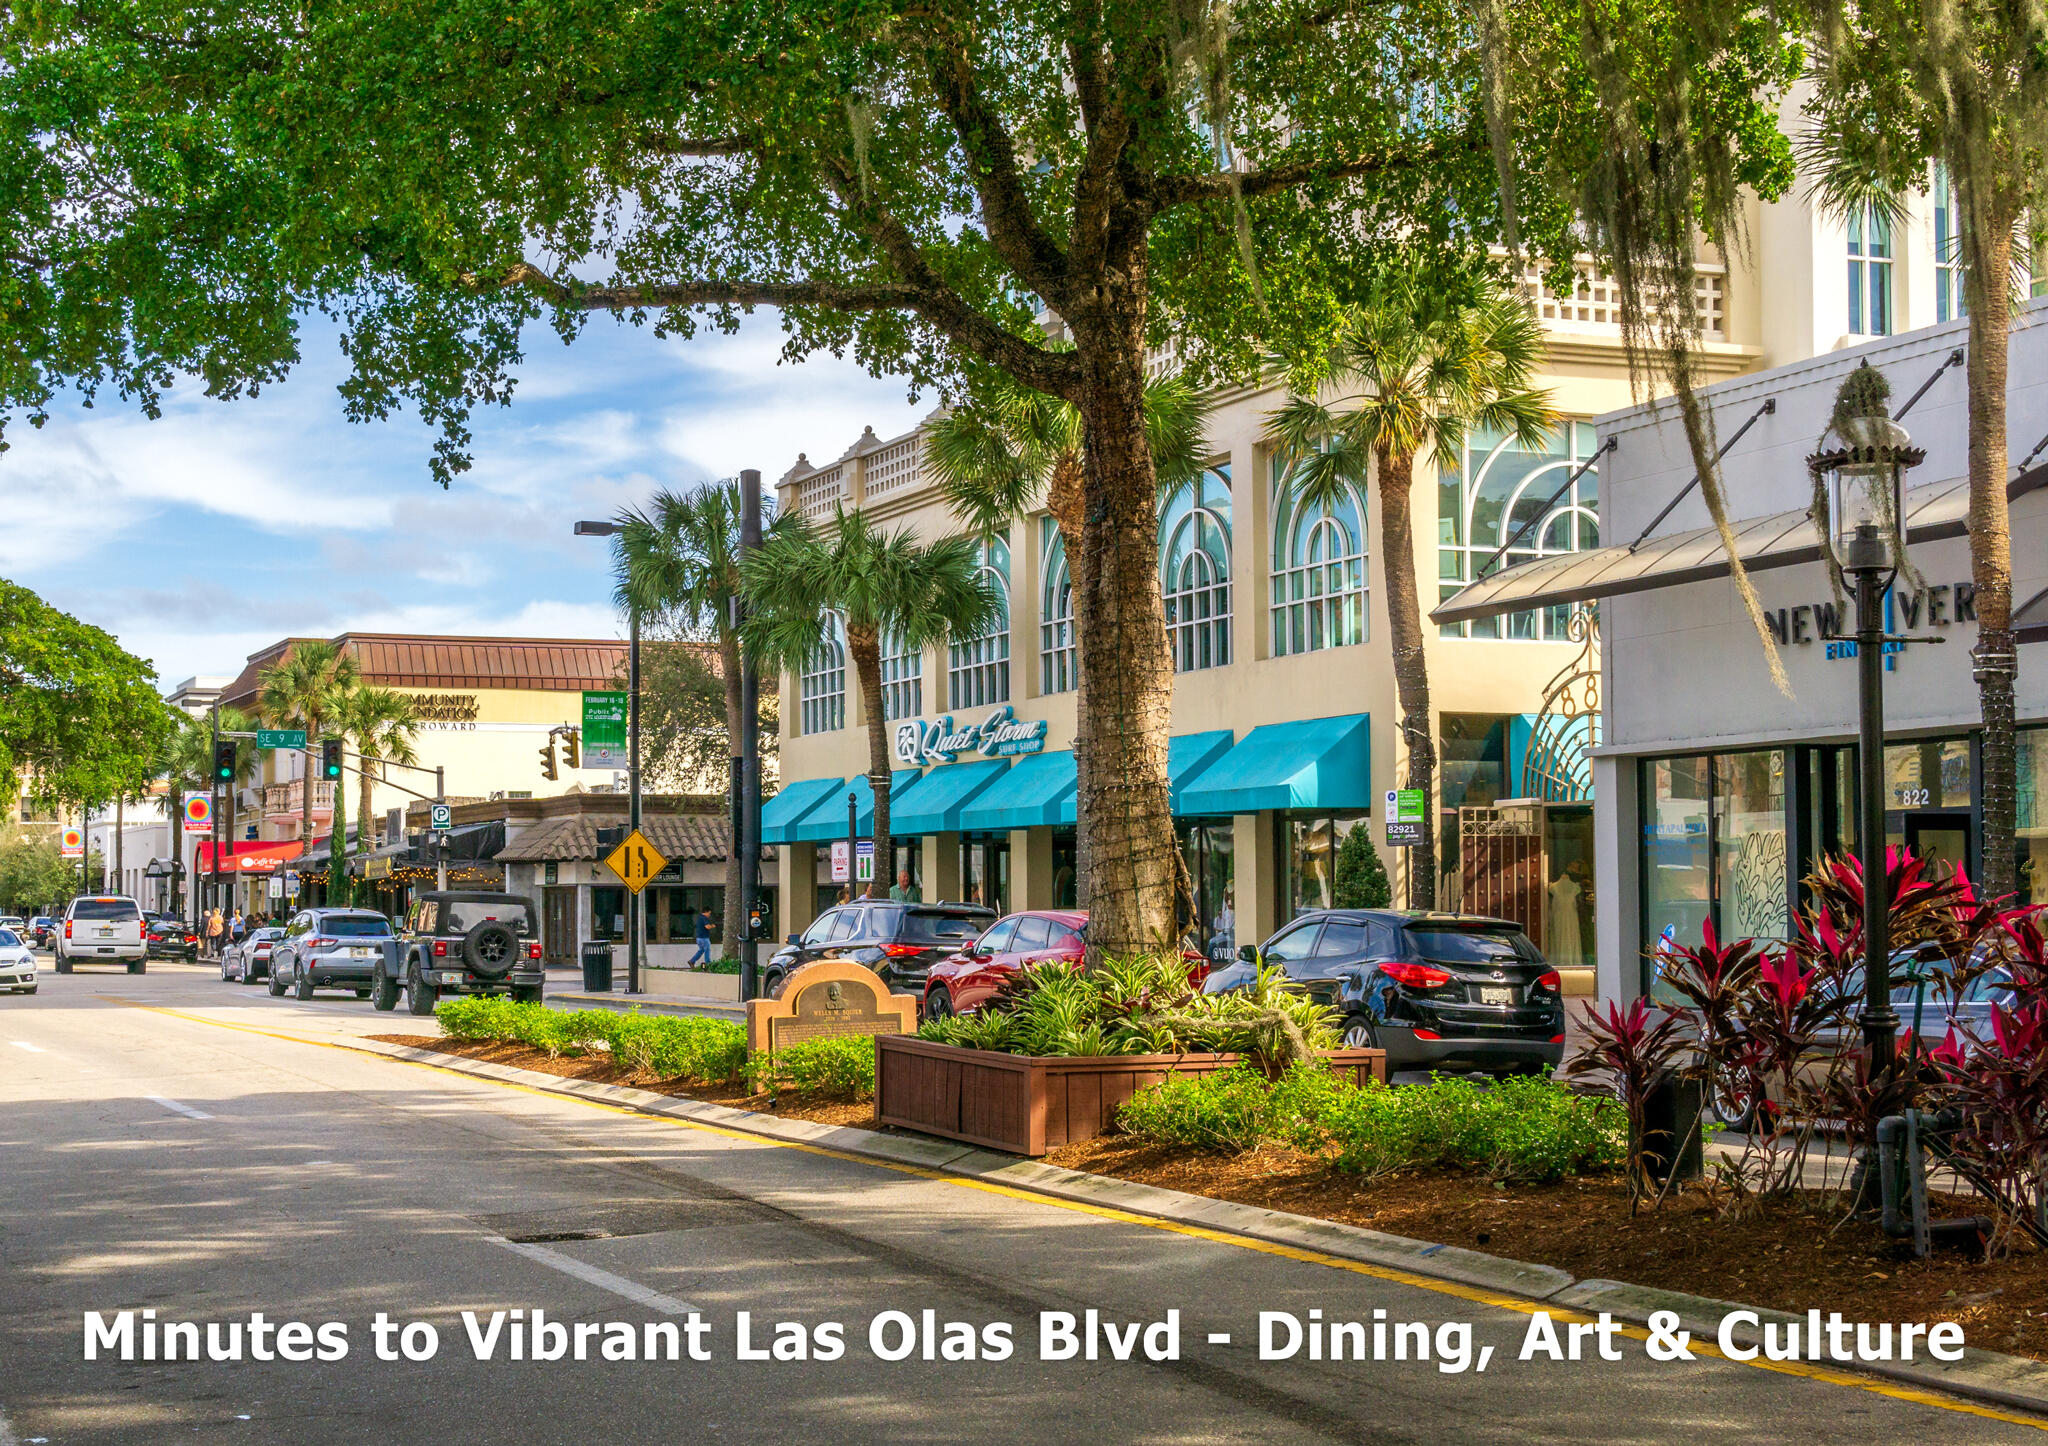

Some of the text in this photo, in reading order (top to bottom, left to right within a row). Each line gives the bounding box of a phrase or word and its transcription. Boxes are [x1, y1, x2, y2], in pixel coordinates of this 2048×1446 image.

[1764, 602, 1846, 645] NEW
[1826, 640, 1858, 661] FIN
[389, 691, 477, 706] MMUNITY
[412, 722, 476, 731] ROWARD
[260, 733, 304, 743] SE 9 AV
[922, 717, 981, 761] Quiet
[978, 706, 1043, 755] Storm
[999, 744, 1016, 753] SURF
[1903, 788, 1929, 806] 822
[1388, 825, 1415, 834] 82921
[837, 847, 843, 857] NO
[833, 857, 848, 866] PARKING
